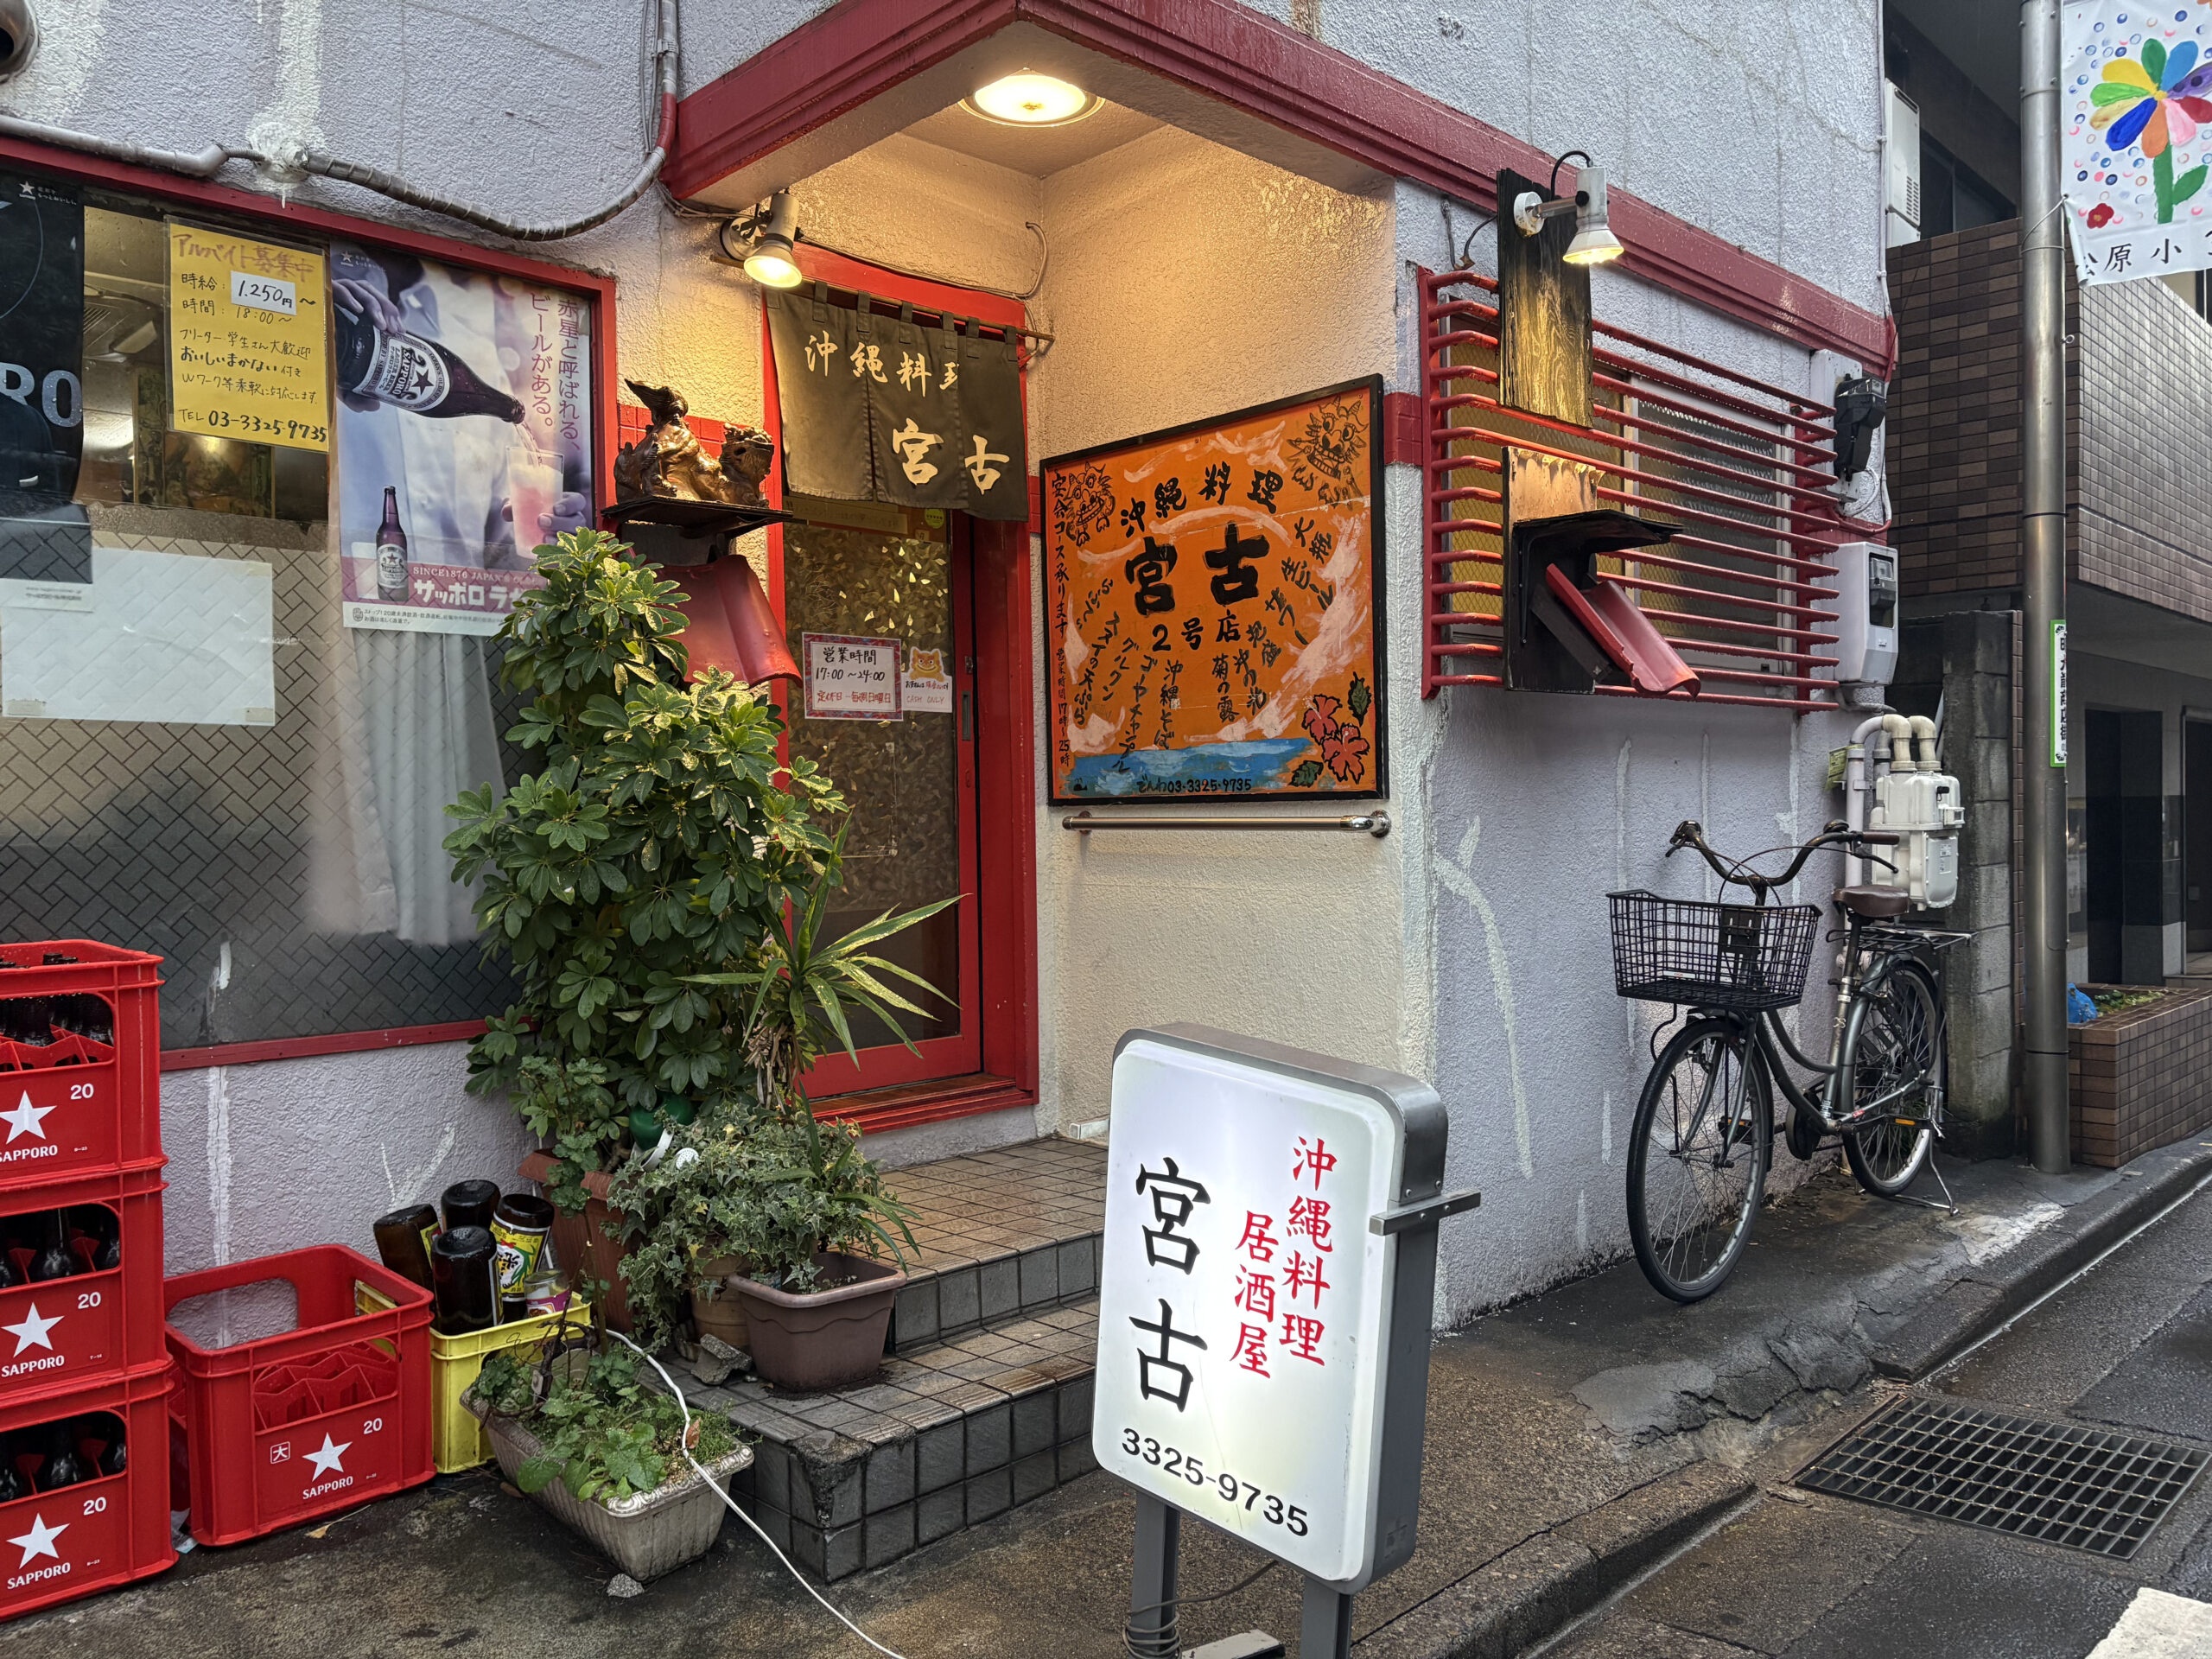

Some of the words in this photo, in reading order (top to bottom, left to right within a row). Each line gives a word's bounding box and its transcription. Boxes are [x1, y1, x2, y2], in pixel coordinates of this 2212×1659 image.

[173, 233, 315, 283] アルバイト募集中
[392, 349, 411, 395] SAPPORO
[530, 293, 554, 428] ビールがある。
[557, 299, 582, 451] 赤星と呼ばれる、
[179, 409, 205, 423] TEL
[893, 417, 1010, 495] 宮古
[1121, 461, 1284, 538] 沖縄料理
[1052, 468, 1070, 639] 宴会コース承ります
[1125, 520, 1270, 618] 宮古
[1281, 556, 1333, 611] 生ビール
[823, 646, 877, 665] 営業時間
[1152, 609, 1241, 652] 2号店
[1246, 620, 1282, 668] 泡盛
[1103, 637, 1140, 702] グルクン
[1212, 653, 1240, 722] 菊の露
[1112, 655, 1159, 773] ゴーヤチャンプル
[1154, 659, 1183, 750] 沖縄そば
[70, 1084, 94, 1100] 20
[1280, 1135, 1338, 1366] 沖縄料理
[77, 1291, 101, 1310] 20
[1129, 1157, 1211, 1414] 宮古
[1230, 1210, 1280, 1378] 居酒屋
[1, 1355, 65, 1377] SAPPORO
[271, 1445, 289, 1462] 大
[363, 1418, 383, 1434] 20
[83, 1497, 107, 1516] 20
[302, 1476, 353, 1499] SAPPORO
[1122, 1427, 1310, 1538] 3325-9735
[7, 1562, 71, 1590] SAPPORO
